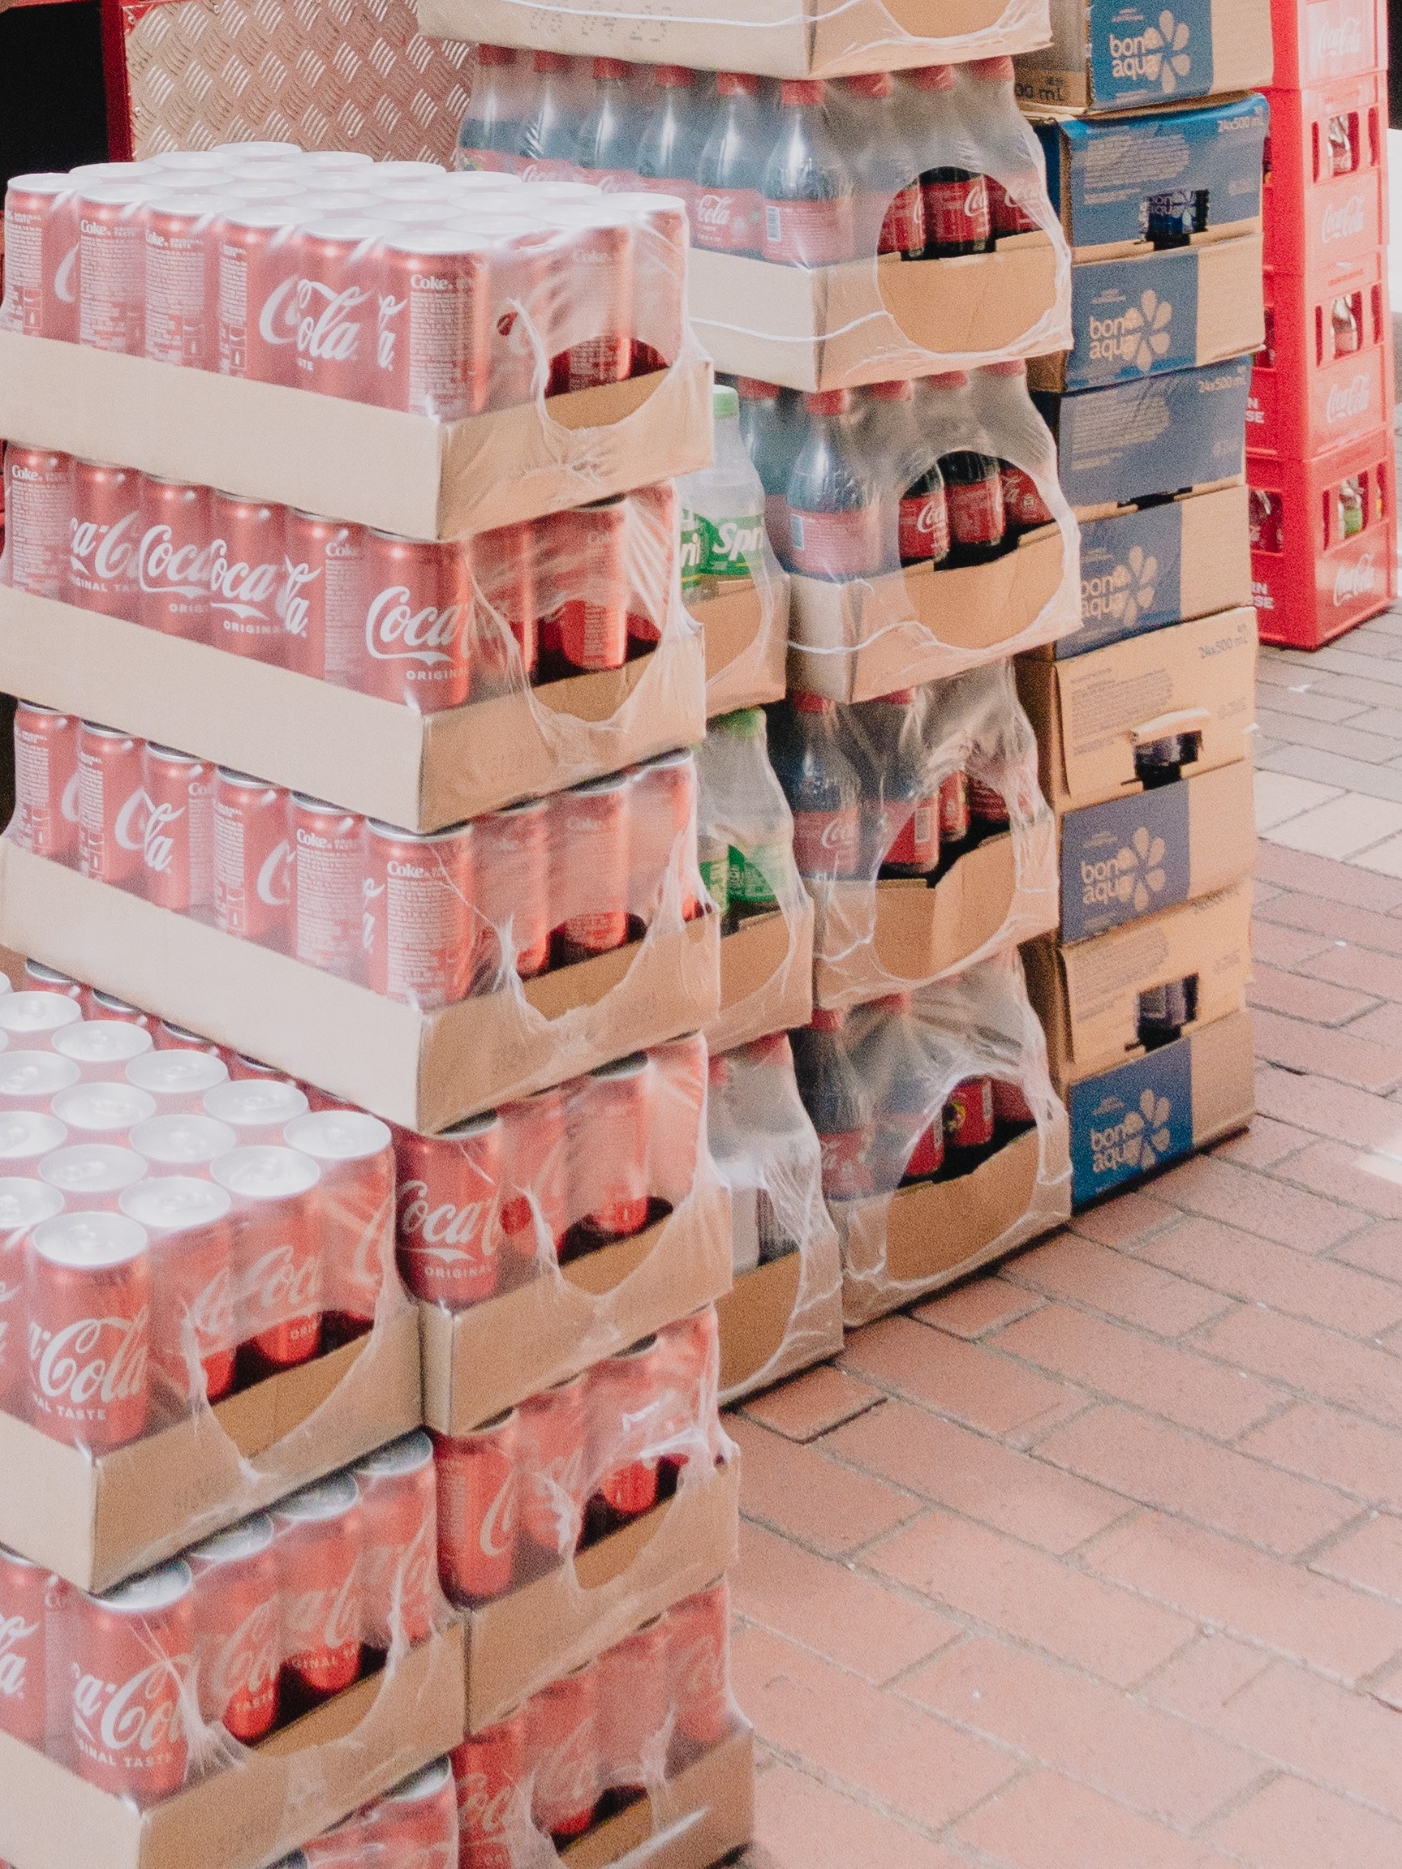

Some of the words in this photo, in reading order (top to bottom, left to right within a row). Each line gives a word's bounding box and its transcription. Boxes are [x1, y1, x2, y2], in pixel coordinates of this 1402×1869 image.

[1109, 34, 1147, 58] bon
[1111, 57, 1158, 80] aqua
[1089, 315, 1125, 339] bon
[1333, 552, 1378, 607] Coca-Cola
[1081, 859, 1120, 881] bon
[1090, 1126, 1128, 1149] bon
[56, 1403, 106, 1421] TASTE
